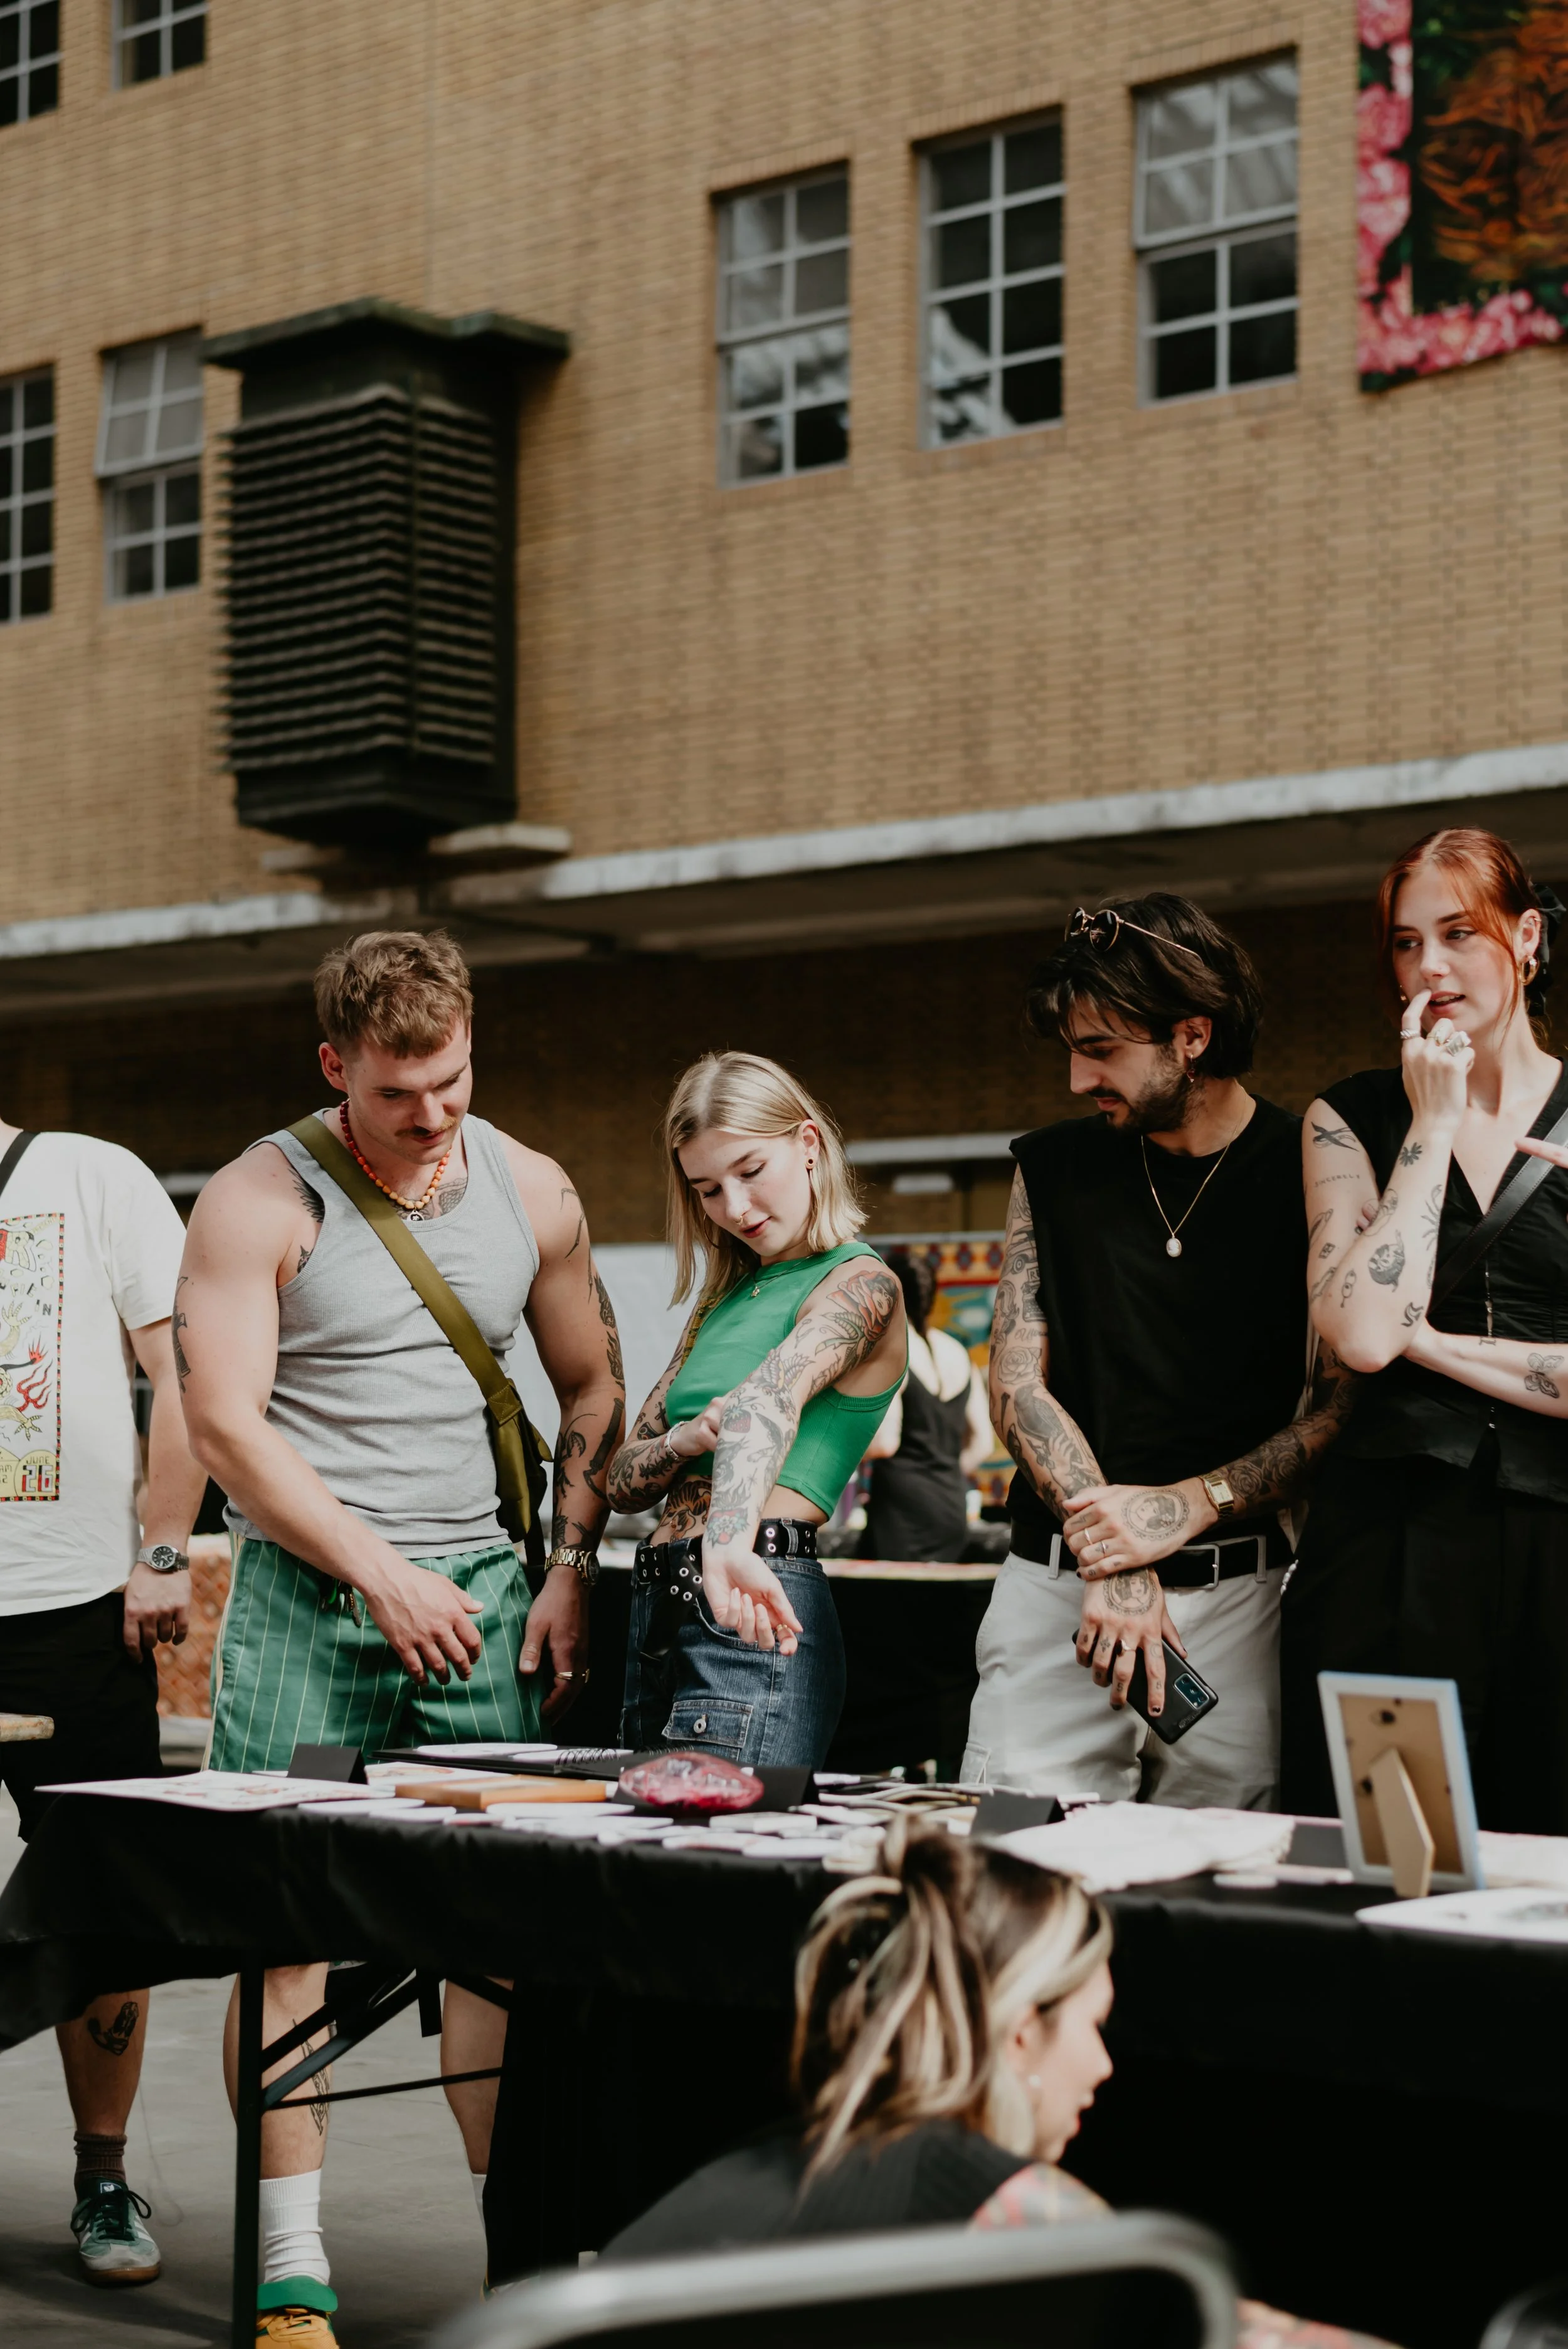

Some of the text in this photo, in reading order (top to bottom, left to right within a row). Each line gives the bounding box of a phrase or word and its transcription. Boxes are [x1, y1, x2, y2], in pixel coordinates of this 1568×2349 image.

[1313, 1174, 1360, 1188] SINCERELY
[26, 1456, 50, 1465] JUNE
[22, 1465, 53, 1493] 26
